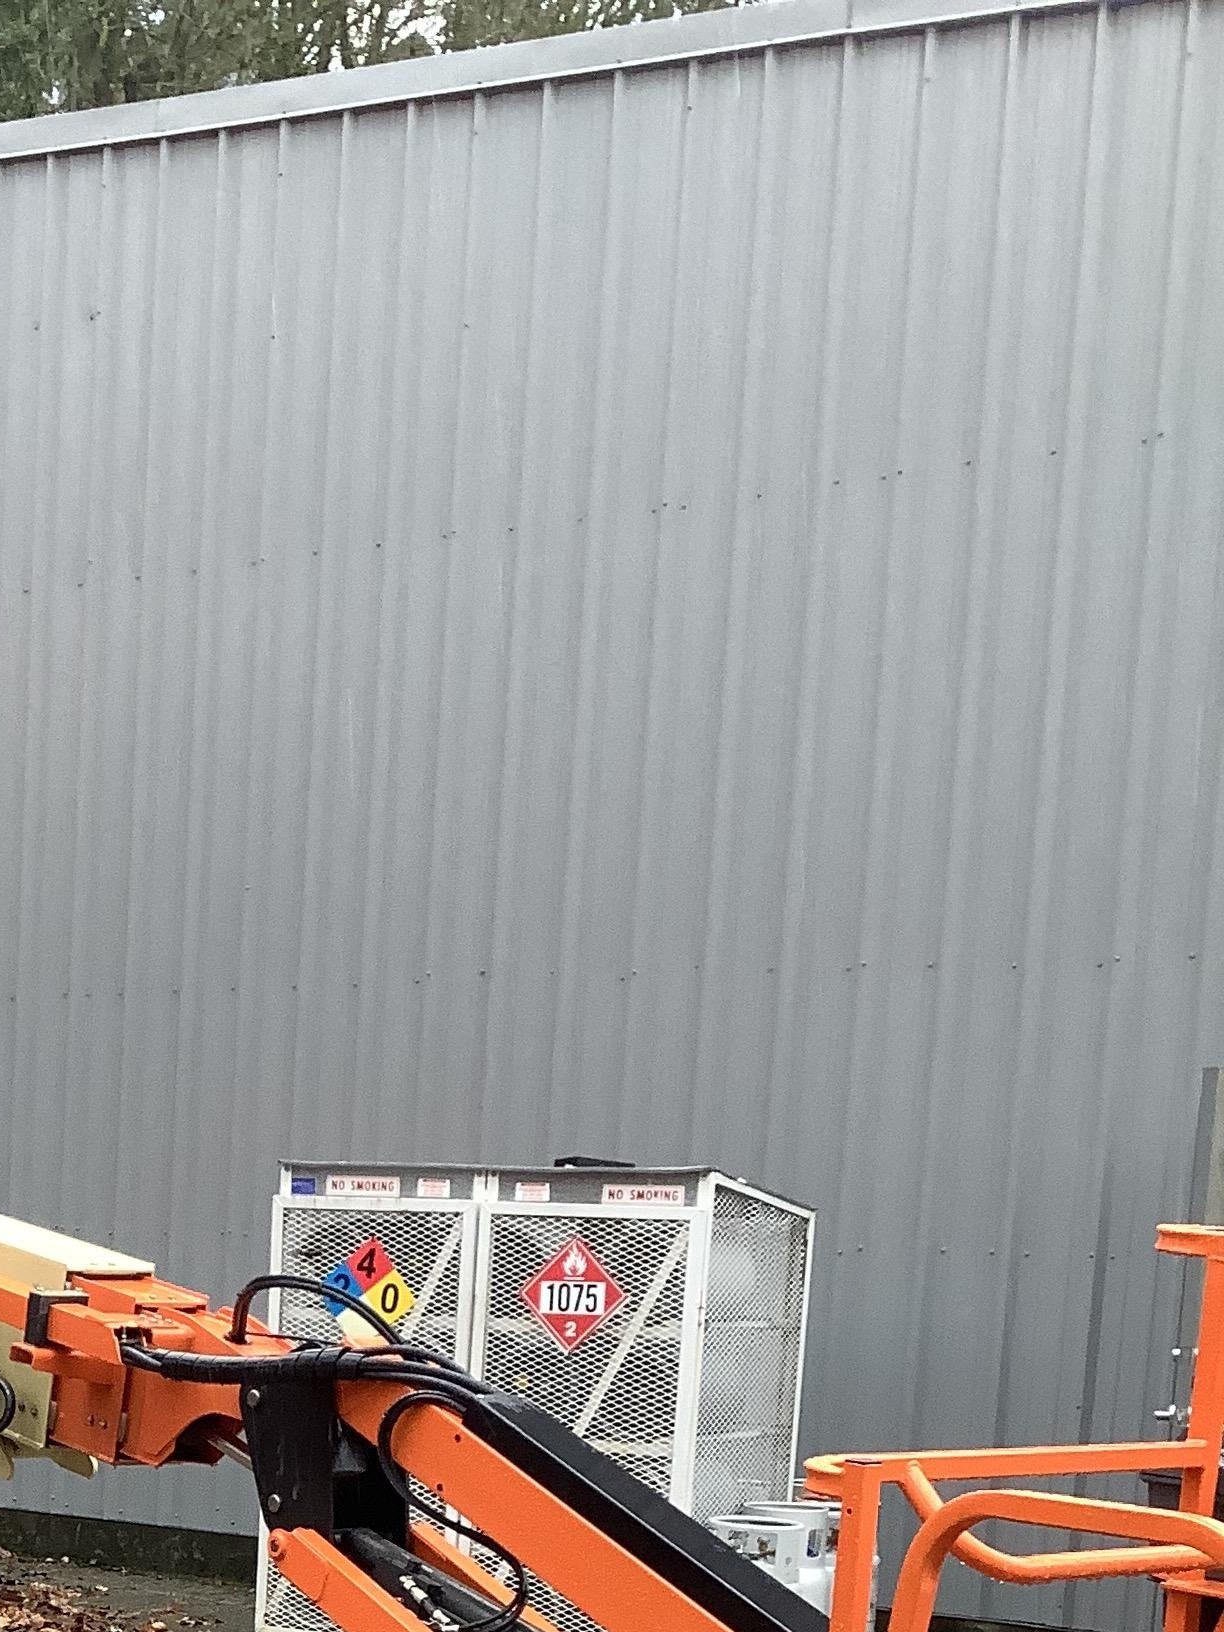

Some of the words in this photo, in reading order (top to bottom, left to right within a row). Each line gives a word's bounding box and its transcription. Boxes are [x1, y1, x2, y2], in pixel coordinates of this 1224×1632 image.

[332, 1179, 345, 1190] NO
[351, 1180, 395, 1191] SMOKING
[608, 1188, 624, 1199] NO
[630, 1189, 679, 1200] SMOKING
[356, 1247, 376, 1279] 4
[380, 1283, 400, 1314] 0
[547, 1283, 598, 1313] 1075
[564, 1321, 577, 1337] 2
